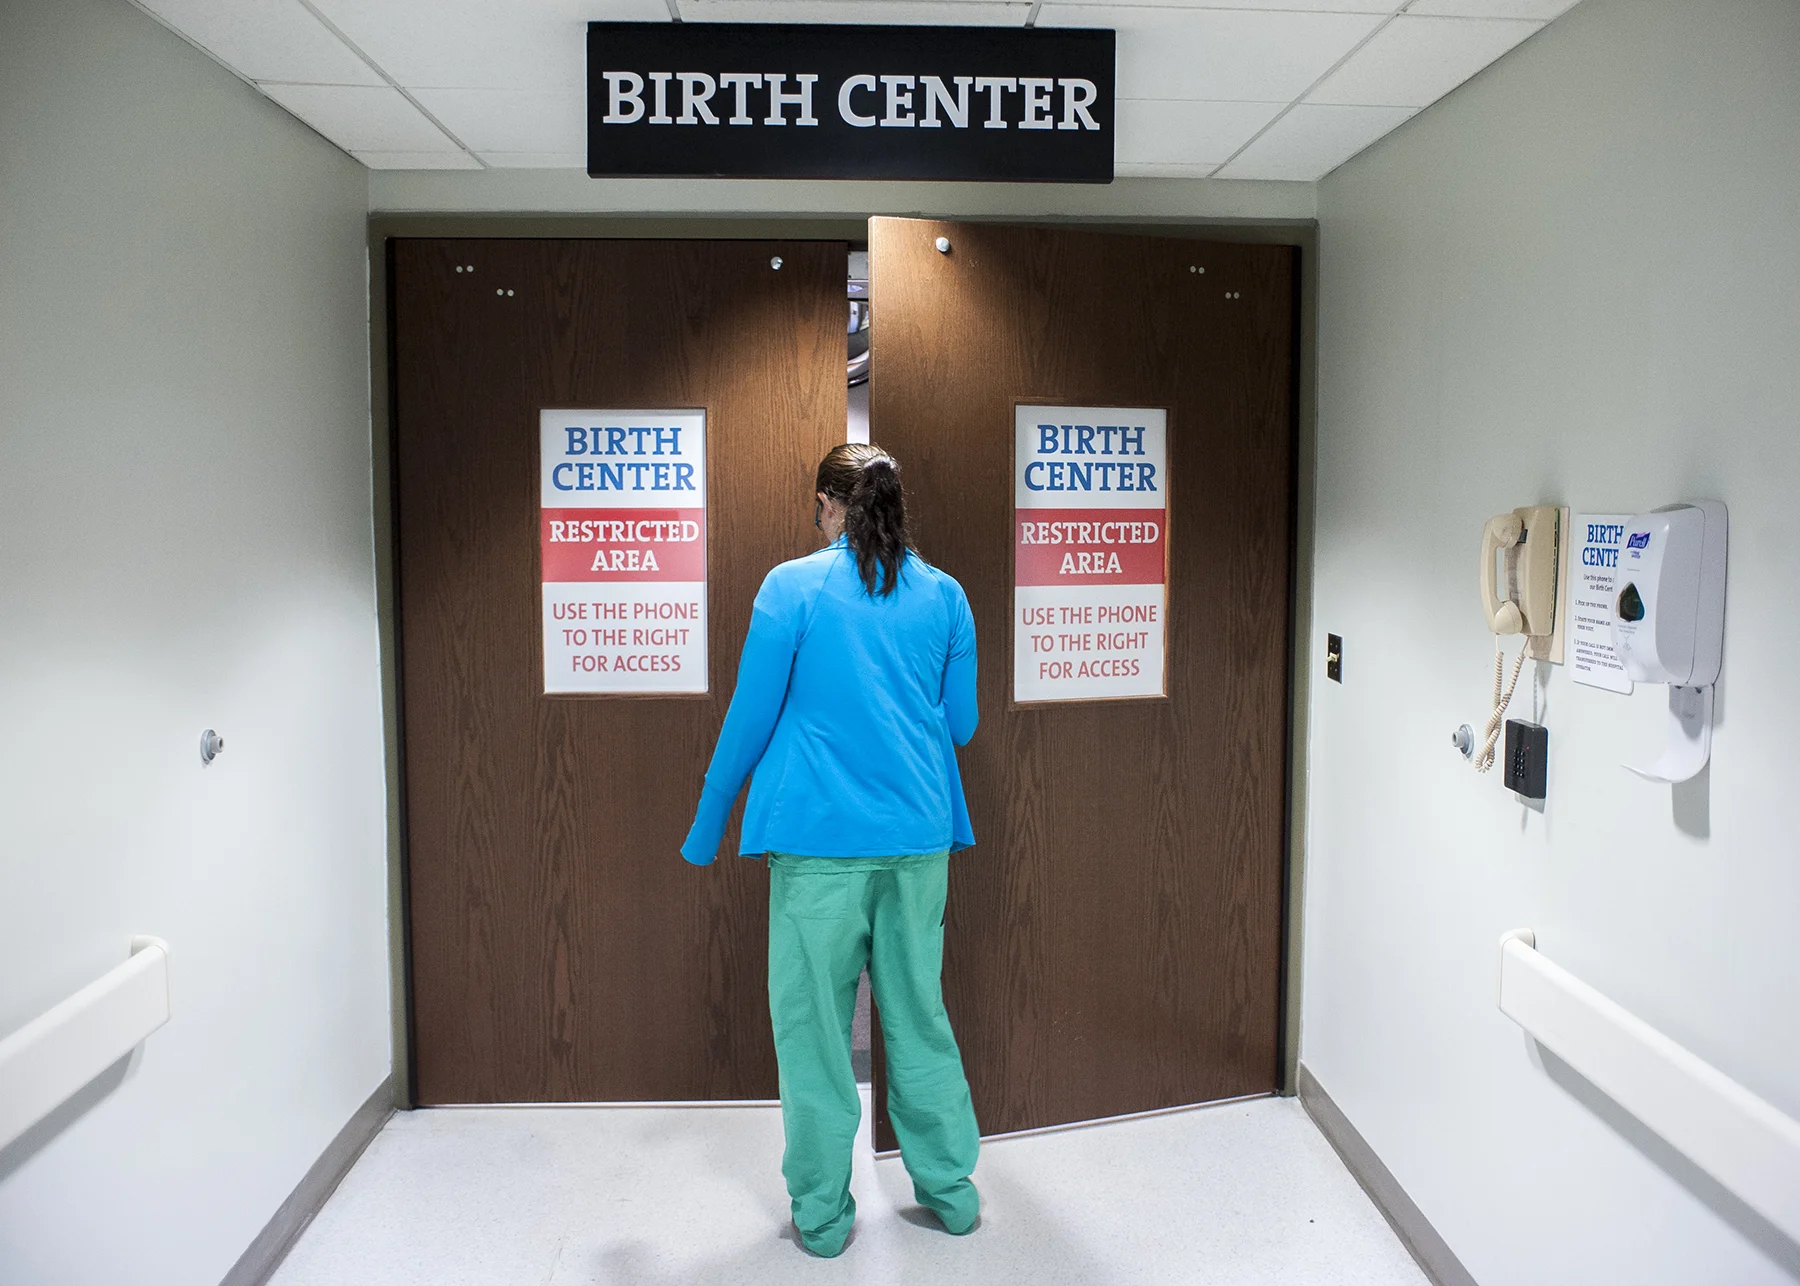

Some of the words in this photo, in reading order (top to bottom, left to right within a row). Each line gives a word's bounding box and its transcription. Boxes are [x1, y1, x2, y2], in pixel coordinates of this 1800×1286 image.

[602, 71, 818, 126] BIRTH
[838, 75, 1100, 130] CENTER
[565, 427, 682, 455] BIRTH
[1037, 424, 1146, 455] BIRTH
[552, 462, 696, 491] CENTER
[1024, 461, 1157, 492] CENTER
[549, 520, 699, 543] RESTRICTED
[1021, 522, 1159, 545] RESTRICTED
[1587, 524, 1624, 544] BIRTH
[591, 550, 659, 571] AREA
[1059, 552, 1122, 574] AREA
[1582, 547, 1619, 567] CENTE
[553, 603, 587, 620] USE
[592, 603, 627, 619] THE
[633, 603, 698, 620] PHONE
[1022, 607, 1054, 626] USE
[1059, 607, 1092, 624] THE
[1098, 605, 1157, 623] PHONE
[563, 629, 587, 646] TO
[592, 629, 627, 646] THE
[633, 629, 690, 646] RIGHT
[1031, 635, 1054, 652] TO
[1059, 634, 1091, 651] THE
[1096, 632, 1148, 650] RIGHT
[572, 655, 608, 672] FOR
[613, 655, 681, 672] ACCESS
[1039, 661, 1073, 680] FOR
[1077, 659, 1140, 678] ACCESS
